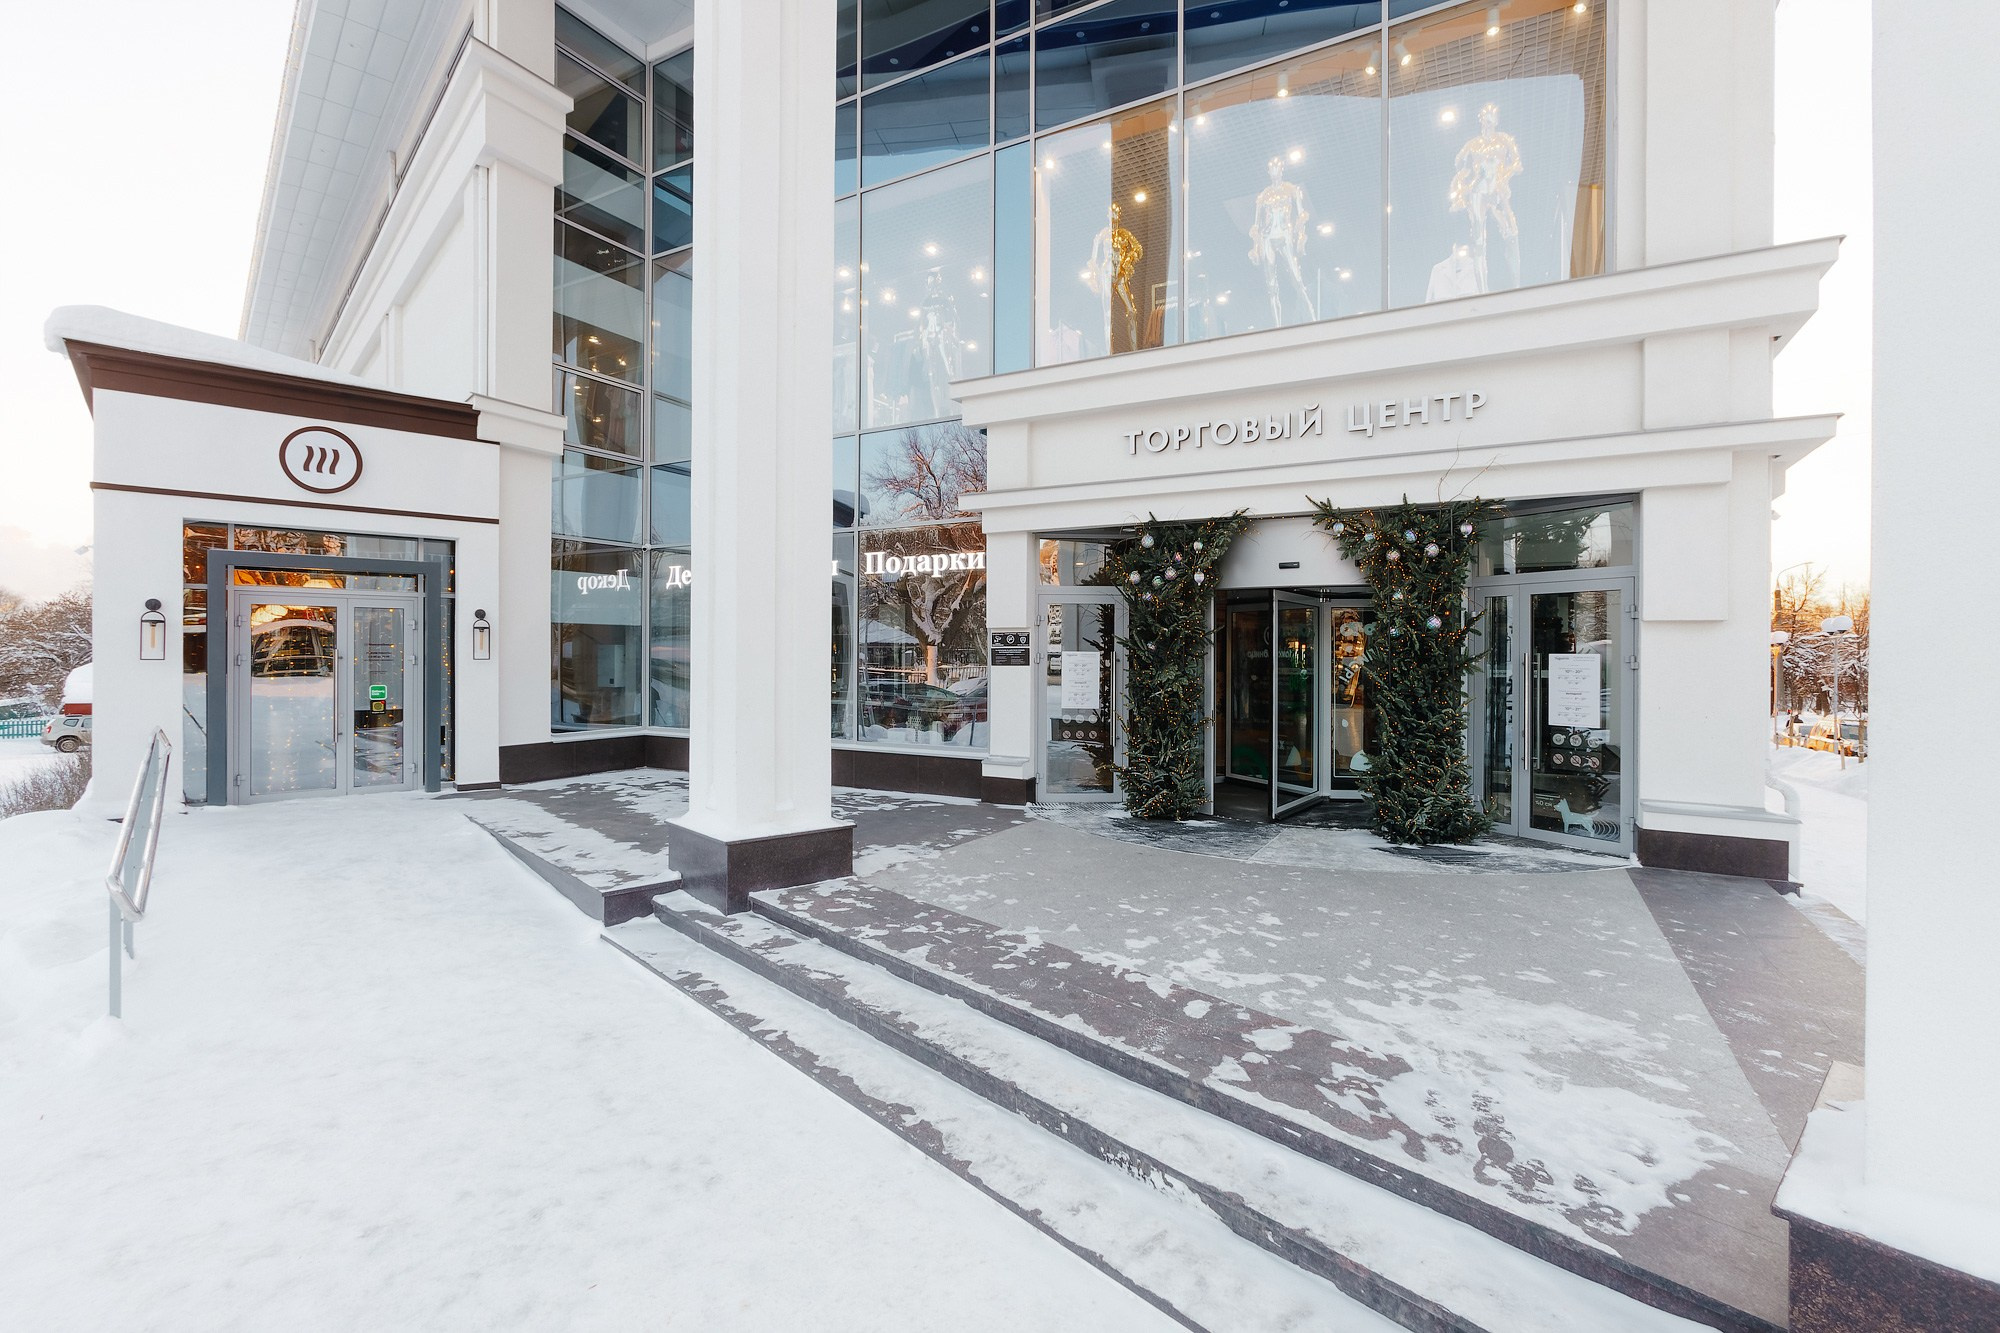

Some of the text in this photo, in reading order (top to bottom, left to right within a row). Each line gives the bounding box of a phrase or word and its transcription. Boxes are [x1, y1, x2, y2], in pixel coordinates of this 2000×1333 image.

[1124, 389, 1488, 455] ТОРГОВЫЙ ЦЕНТР
[864, 551, 985, 578] Подарки
